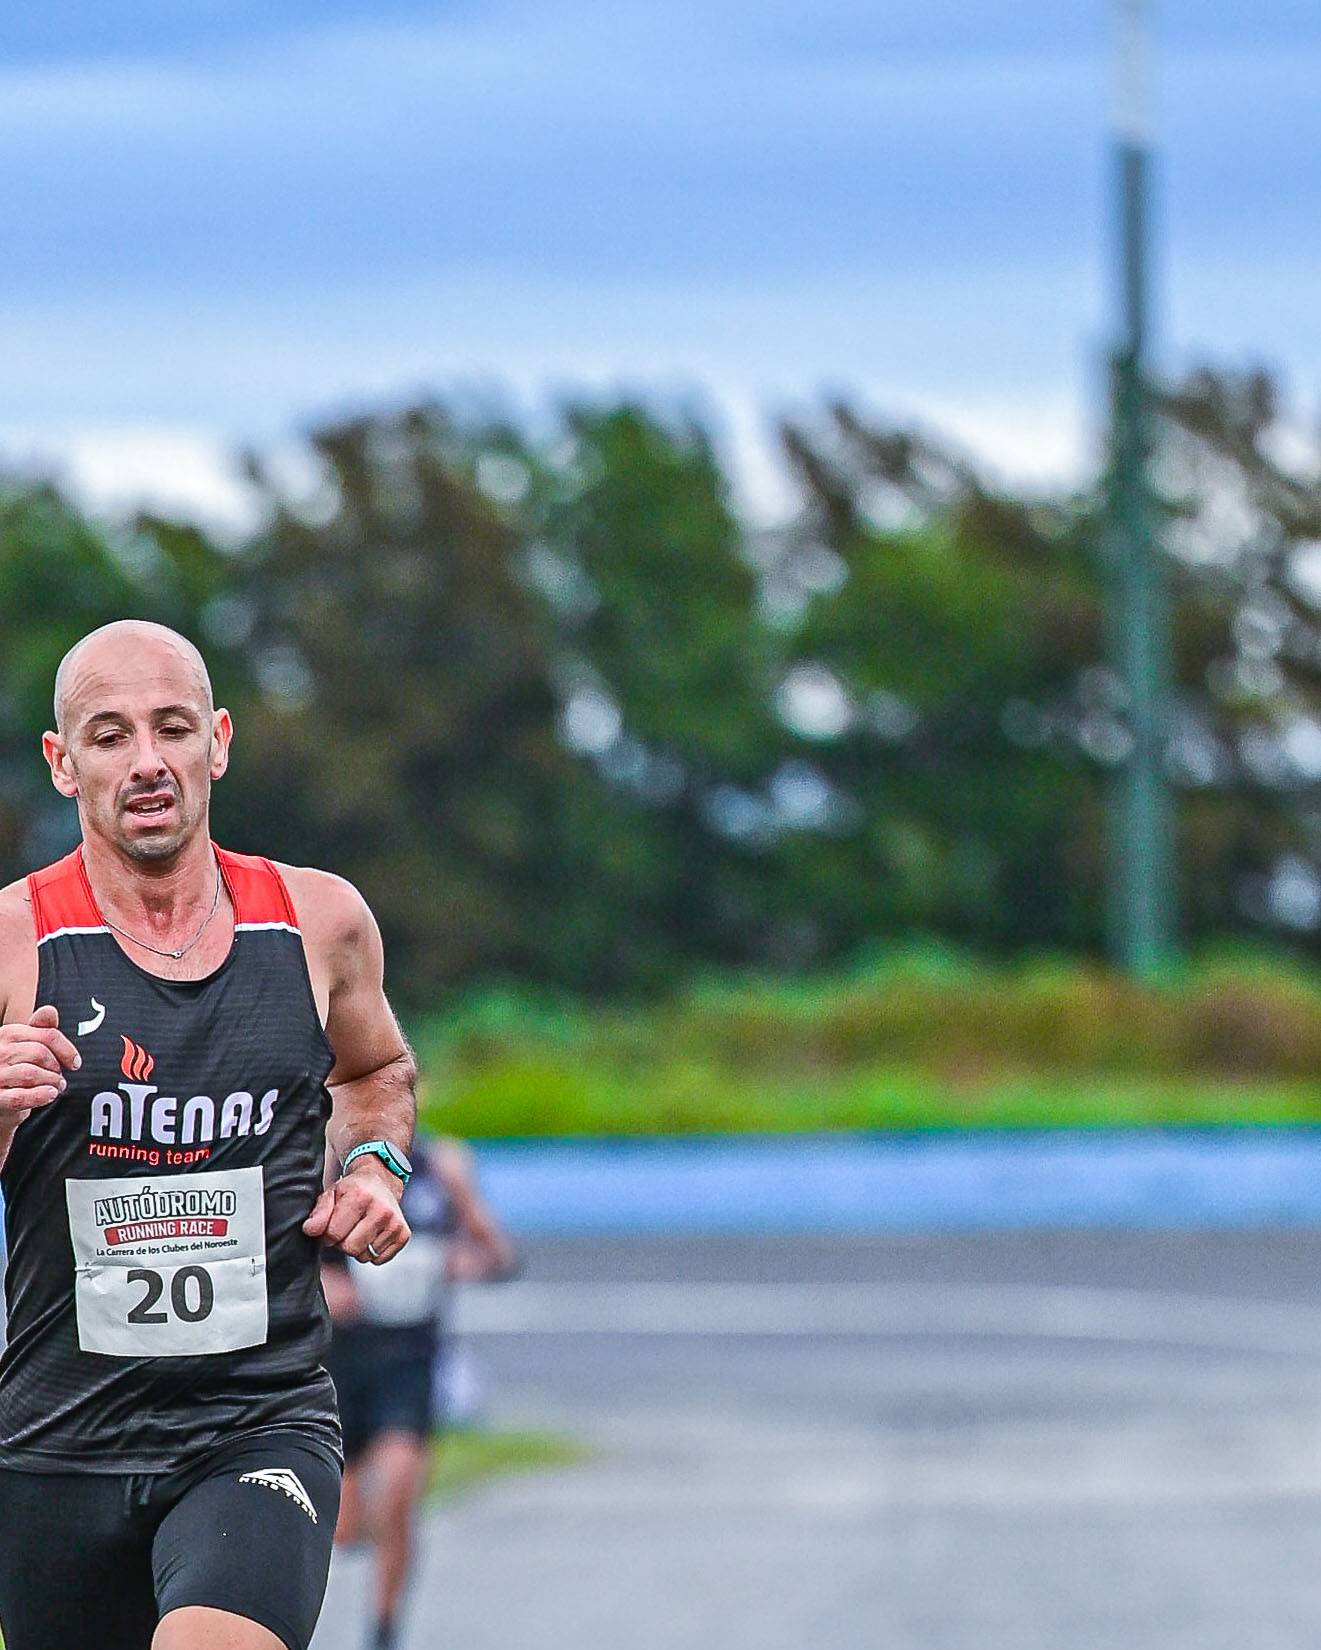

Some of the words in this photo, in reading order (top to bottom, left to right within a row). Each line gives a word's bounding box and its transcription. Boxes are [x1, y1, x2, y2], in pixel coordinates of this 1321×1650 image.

[90, 1082, 279, 1145] ATENAS
[89, 1142, 160, 1166] running
[167, 1146, 210, 1165] team
[94, 1186, 236, 1226] AUTÓDROMO
[96, 1248, 105, 1256] La
[106, 1247, 134, 1256] Carrera
[136, 1246, 146, 1255] de
[148, 1245, 160, 1254] los
[162, 1243, 189, 1253] Clubes
[190, 1240, 203, 1250] del
[204, 1239, 238, 1249] Noroeste
[117, 1221, 176, 1242] RUNNING
[180, 1221, 214, 1236] RACE
[127, 1265, 214, 1324] 20
